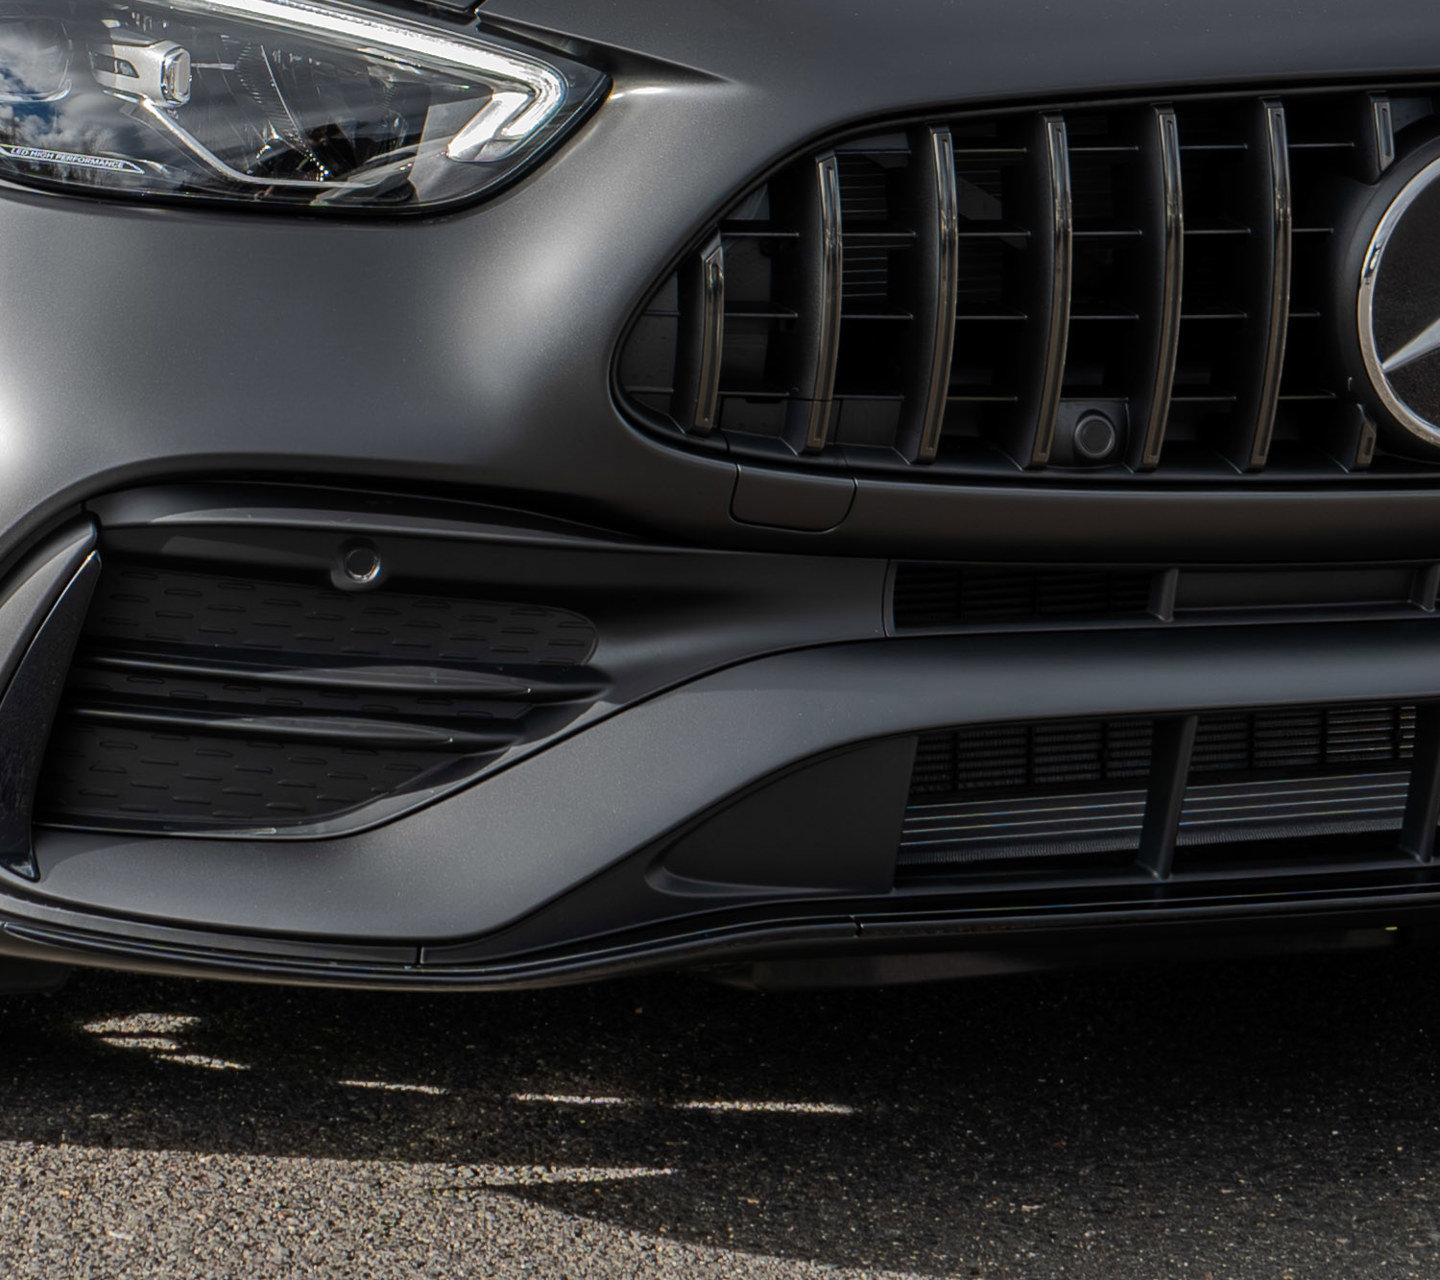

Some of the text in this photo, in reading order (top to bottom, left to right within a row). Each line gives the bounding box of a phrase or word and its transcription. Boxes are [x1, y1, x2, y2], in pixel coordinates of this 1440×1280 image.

[10, 147, 124, 169] LED HIGH PERFORMANCE
